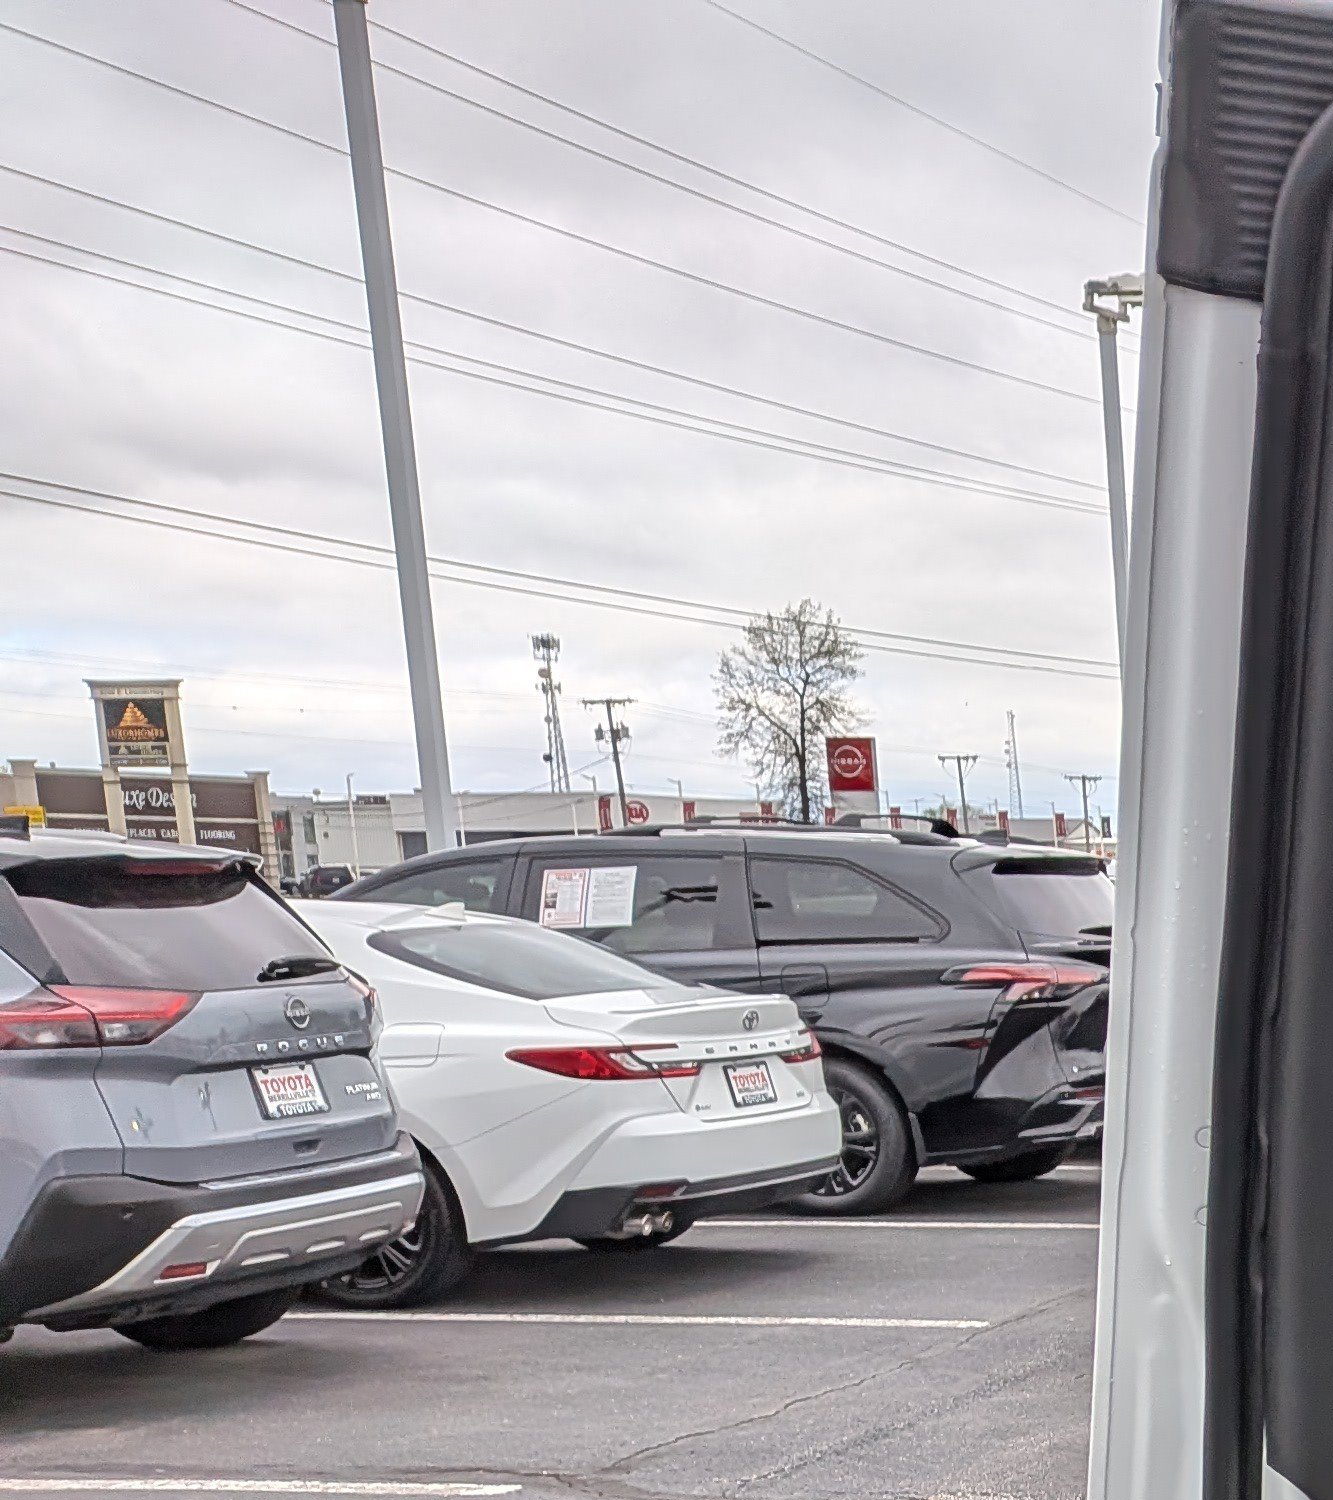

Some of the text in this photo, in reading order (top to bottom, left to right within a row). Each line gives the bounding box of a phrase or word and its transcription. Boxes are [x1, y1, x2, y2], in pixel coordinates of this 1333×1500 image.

[260, 1073, 315, 1095] TOYOTA
[732, 1071, 768, 1088] TOYOTA
[280, 1101, 315, 1116] TOYOTA
